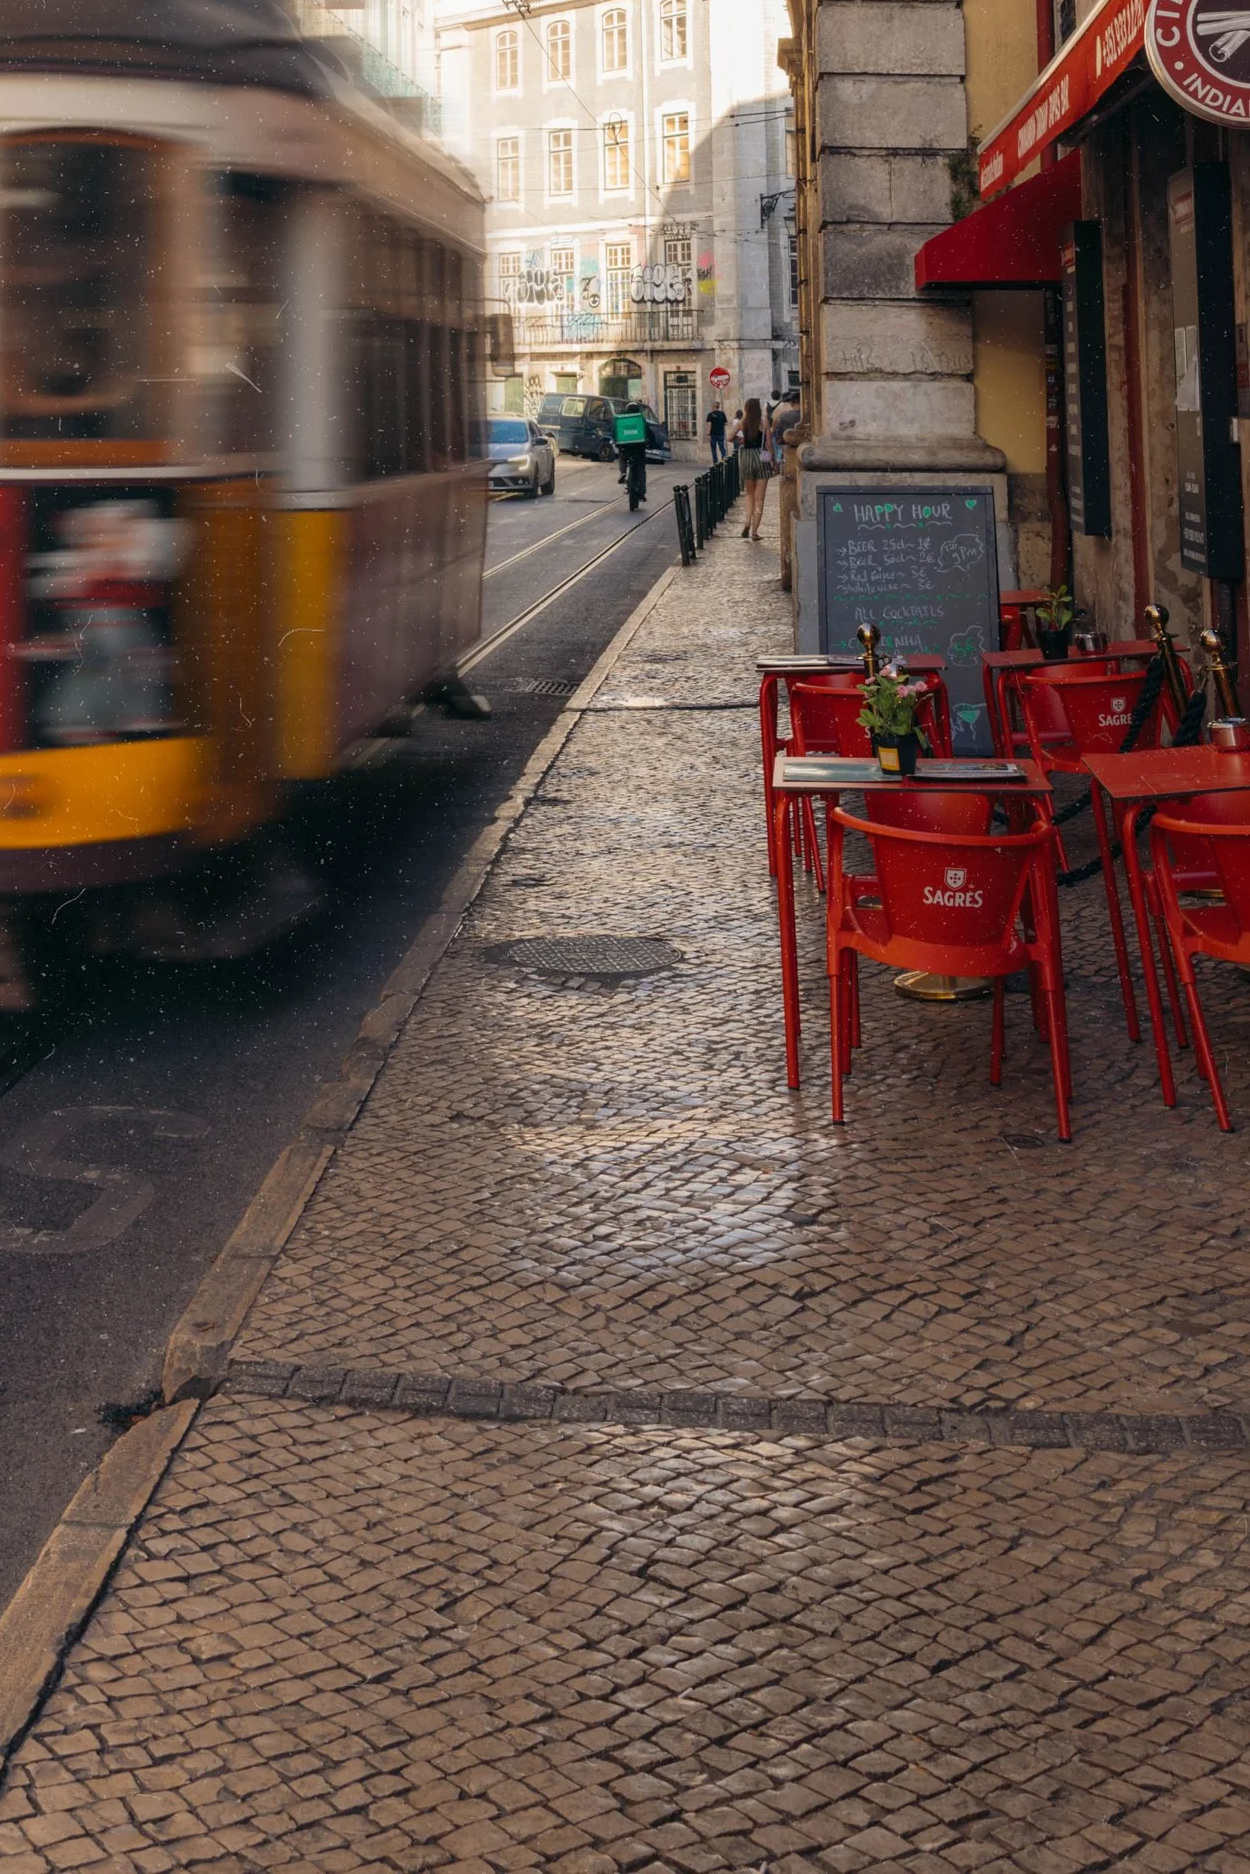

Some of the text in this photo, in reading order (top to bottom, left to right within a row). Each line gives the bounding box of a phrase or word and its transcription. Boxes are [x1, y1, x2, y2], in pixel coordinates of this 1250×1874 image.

[1183, 73, 1250, 117] INDIA
[854, 502, 954, 523] HAPPY HOUR
[847, 539, 877, 555] BEER
[855, 605, 945, 622] ALL COCKTAILS
[1098, 712, 1133, 727] SAGRE
[922, 886, 984, 909] SAGRES
